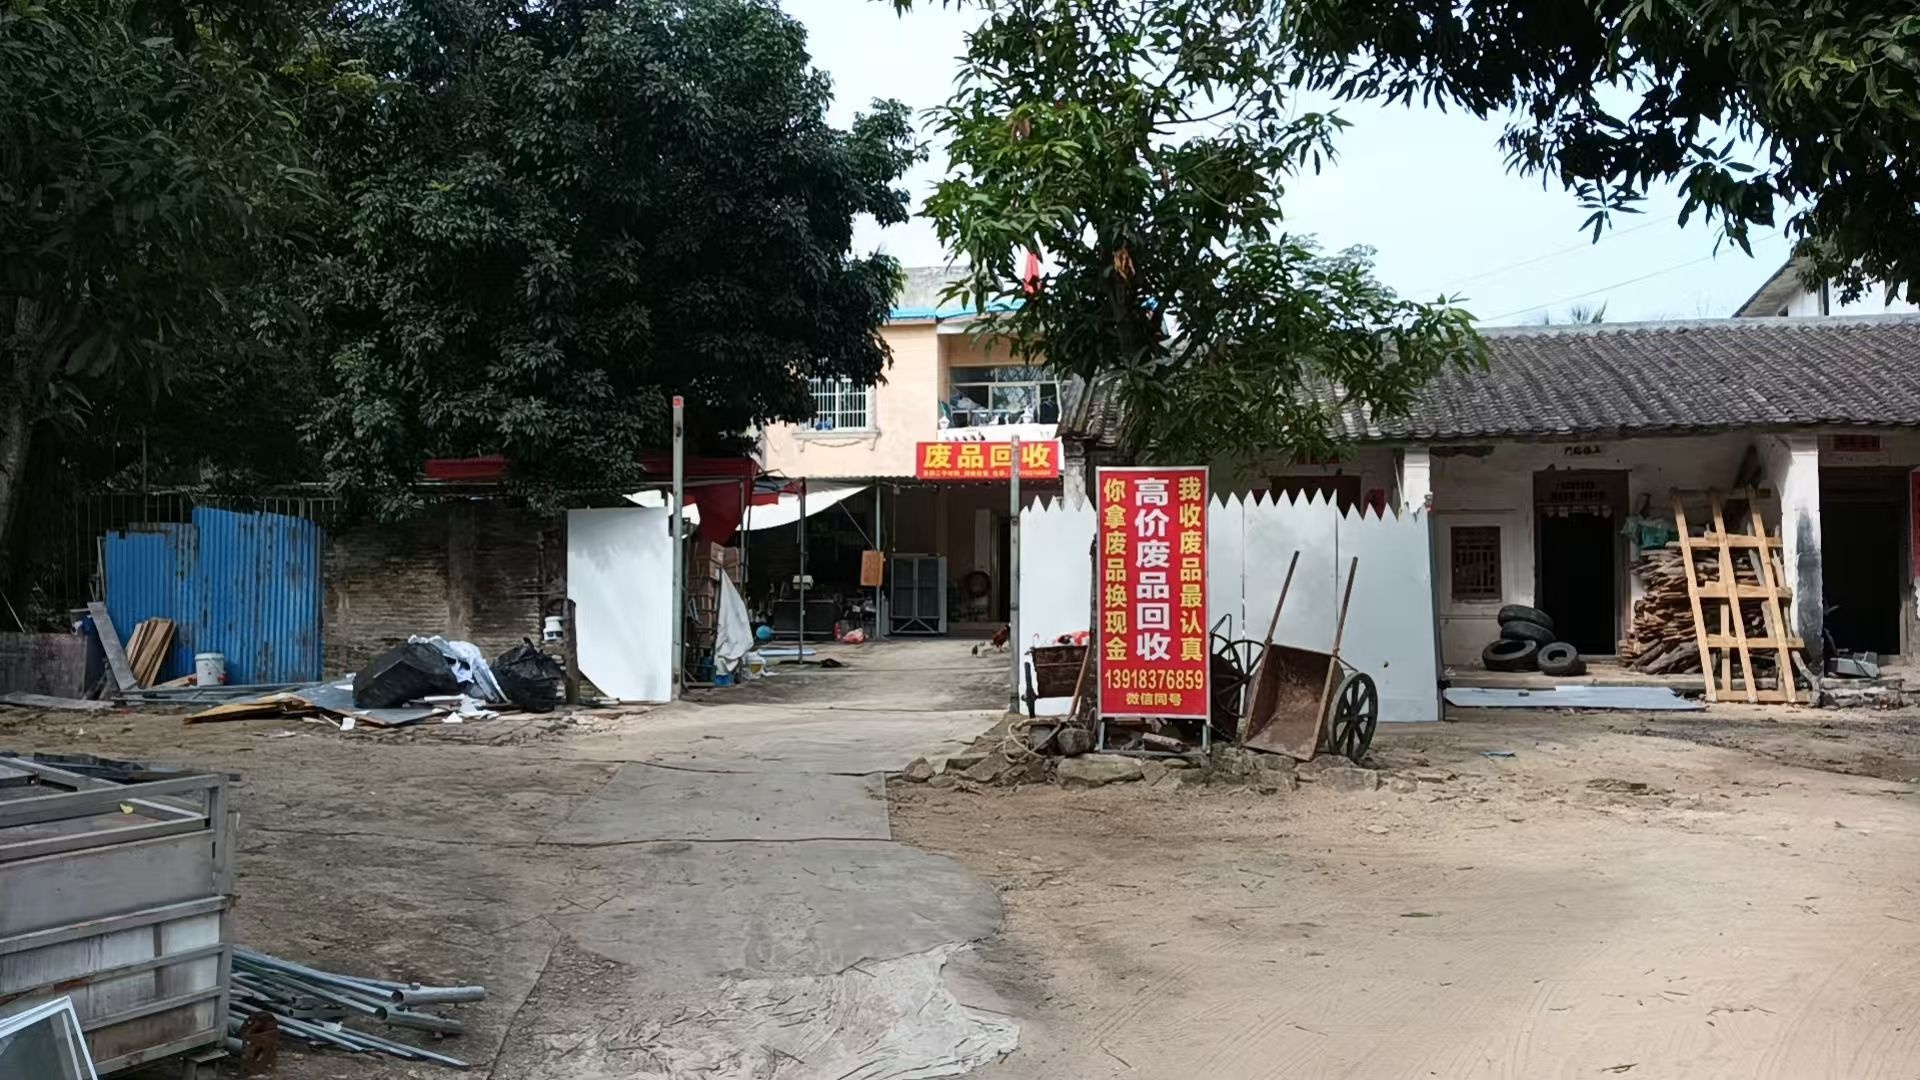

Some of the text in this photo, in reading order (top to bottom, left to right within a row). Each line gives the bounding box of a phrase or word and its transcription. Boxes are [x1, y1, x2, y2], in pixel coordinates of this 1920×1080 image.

[923, 443, 1052, 469] 废品回收
[1104, 477, 1128, 661] 你拿废品换现金
[1134, 477, 1171, 661] 高价废品回收
[1179, 476, 1204, 661] 我收废品最认真
[1105, 669, 1204, 690] 13918376859
[1126, 692, 1182, 706] 微信同号
